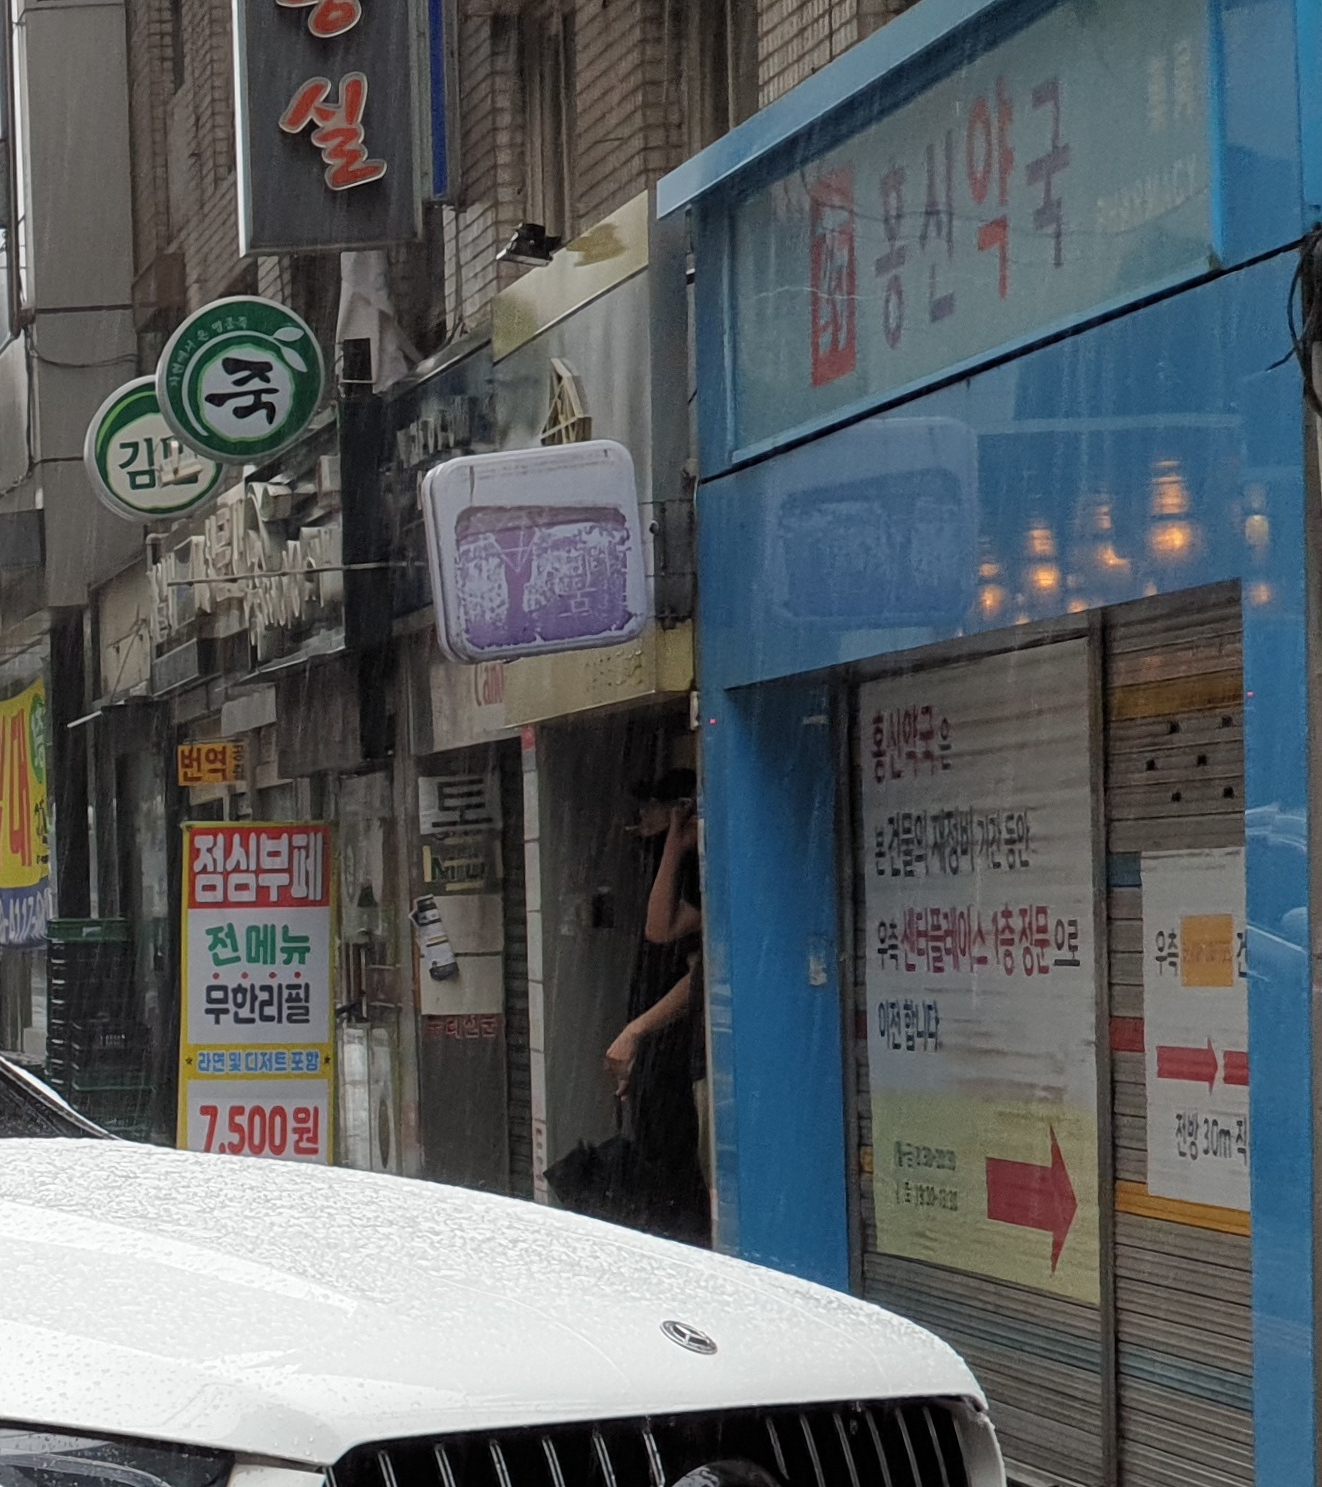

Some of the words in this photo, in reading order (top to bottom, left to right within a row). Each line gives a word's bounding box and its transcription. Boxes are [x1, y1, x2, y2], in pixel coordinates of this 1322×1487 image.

[205, 357, 280, 425] 죽
[180, 745, 228, 783] 번역
[193, 832, 323, 903] 점심부페
[204, 982, 311, 1025] 무한리필
[198, 1051, 225, 1072] 라면
[245, 1051, 287, 1072] 디저트
[291, 1051, 319, 1072] 포함
